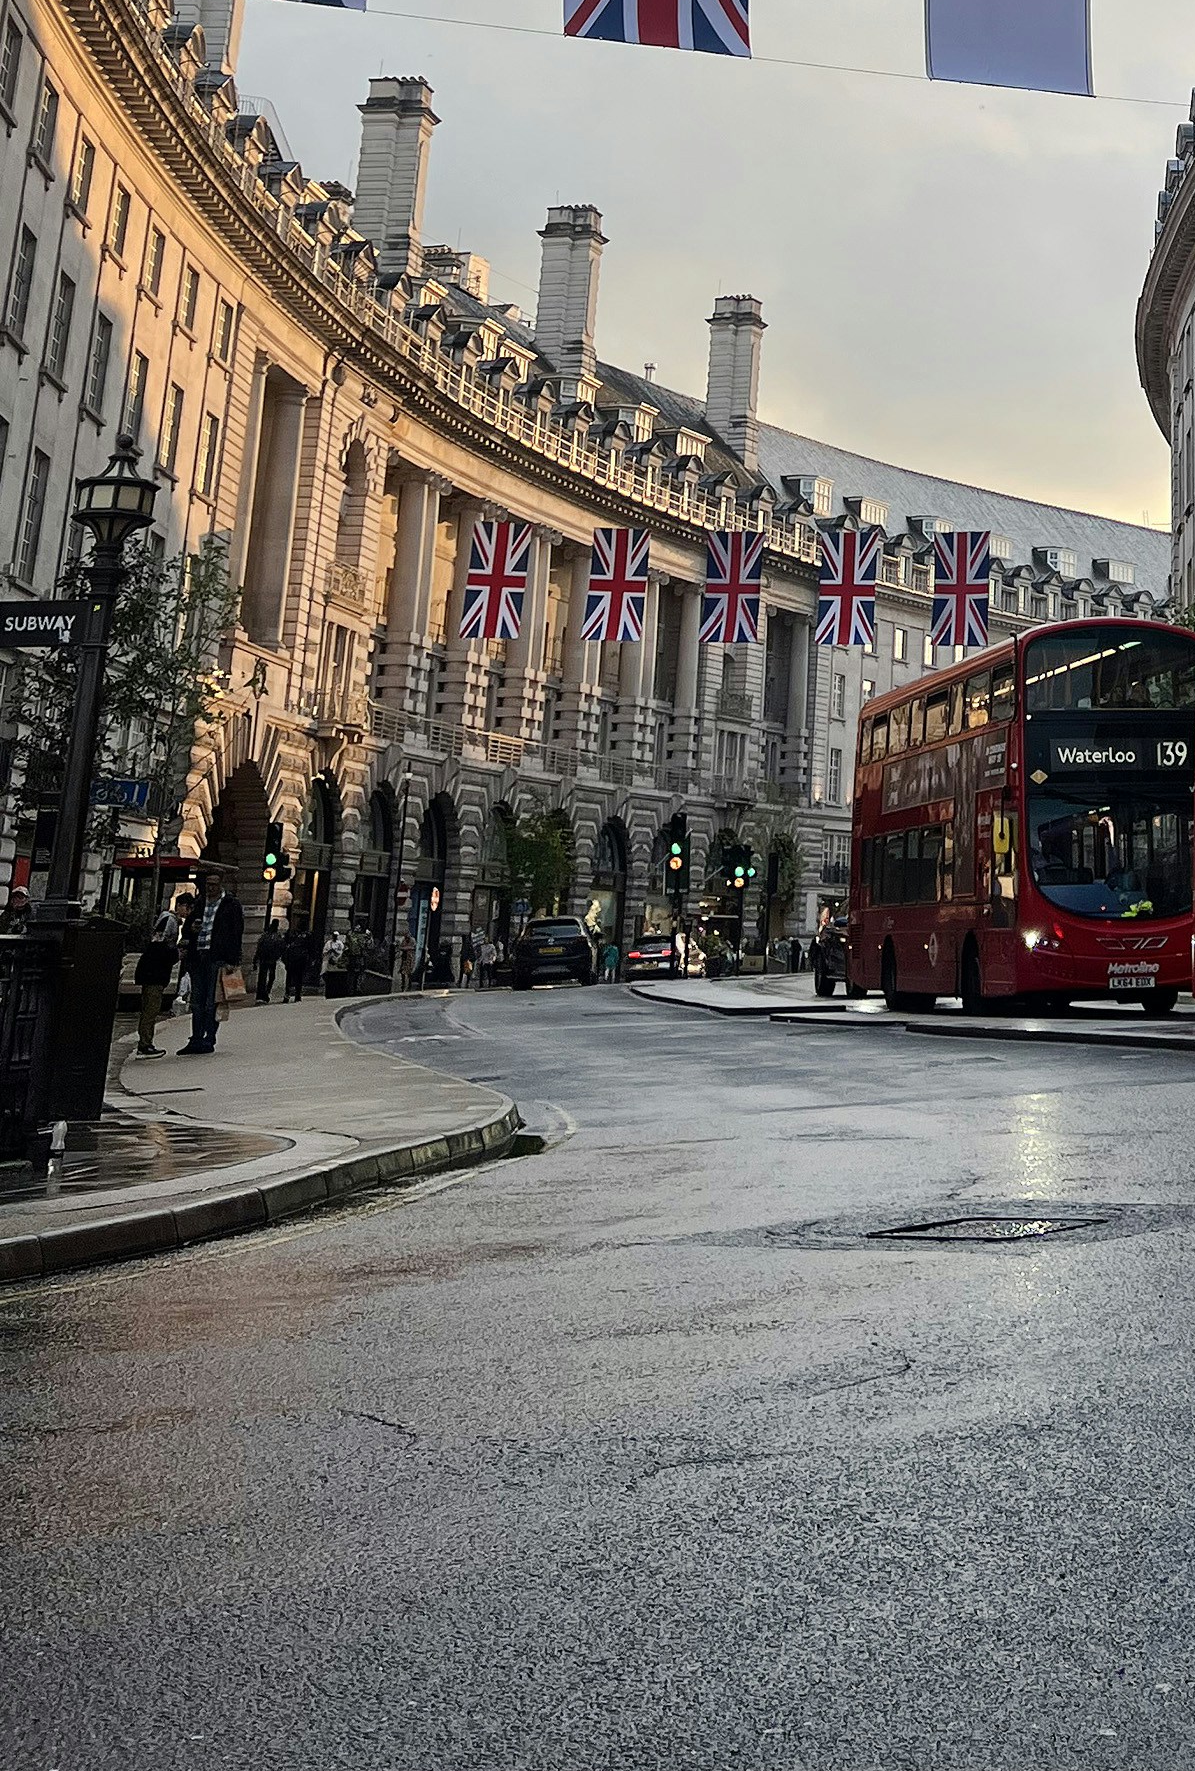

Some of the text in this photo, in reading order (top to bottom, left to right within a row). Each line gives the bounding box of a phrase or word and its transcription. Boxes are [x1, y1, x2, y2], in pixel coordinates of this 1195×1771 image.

[4, 615, 76, 631] SUBWAY
[1057, 741, 1188, 767] Waterloo 139
[1107, 960, 1160, 976] Metroline
